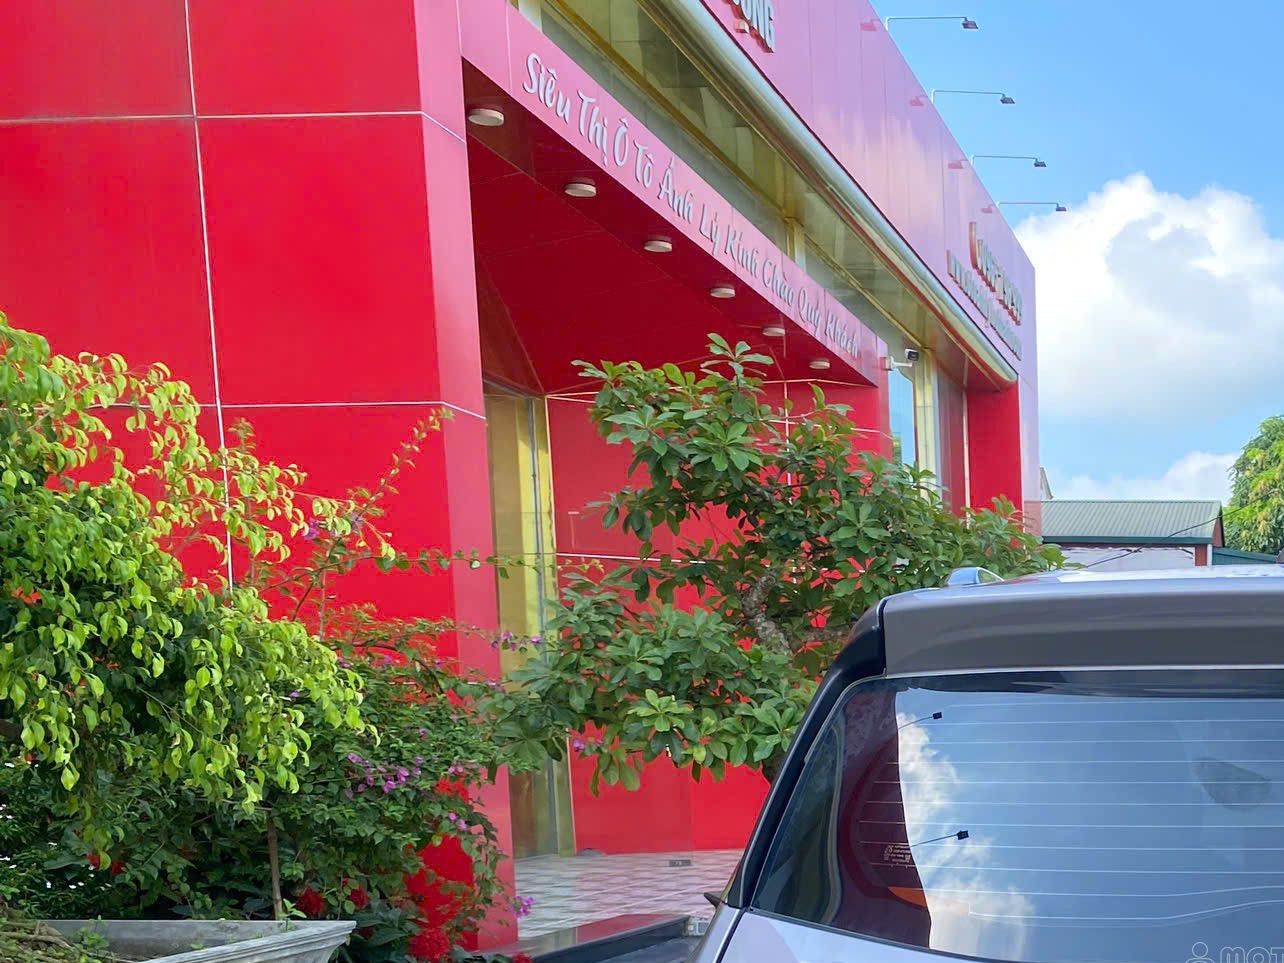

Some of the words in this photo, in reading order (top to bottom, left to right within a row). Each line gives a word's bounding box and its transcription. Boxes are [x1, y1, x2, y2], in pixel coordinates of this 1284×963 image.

[523, 52, 570, 124] Siêu
[577, 89, 608, 167] Thị
[613, 117, 629, 167] Ô
[633, 139, 654, 188] Tô
[657, 157, 695, 224] Ánh
[699, 203, 719, 256] Lý
[762, 257, 795, 308] Chào
